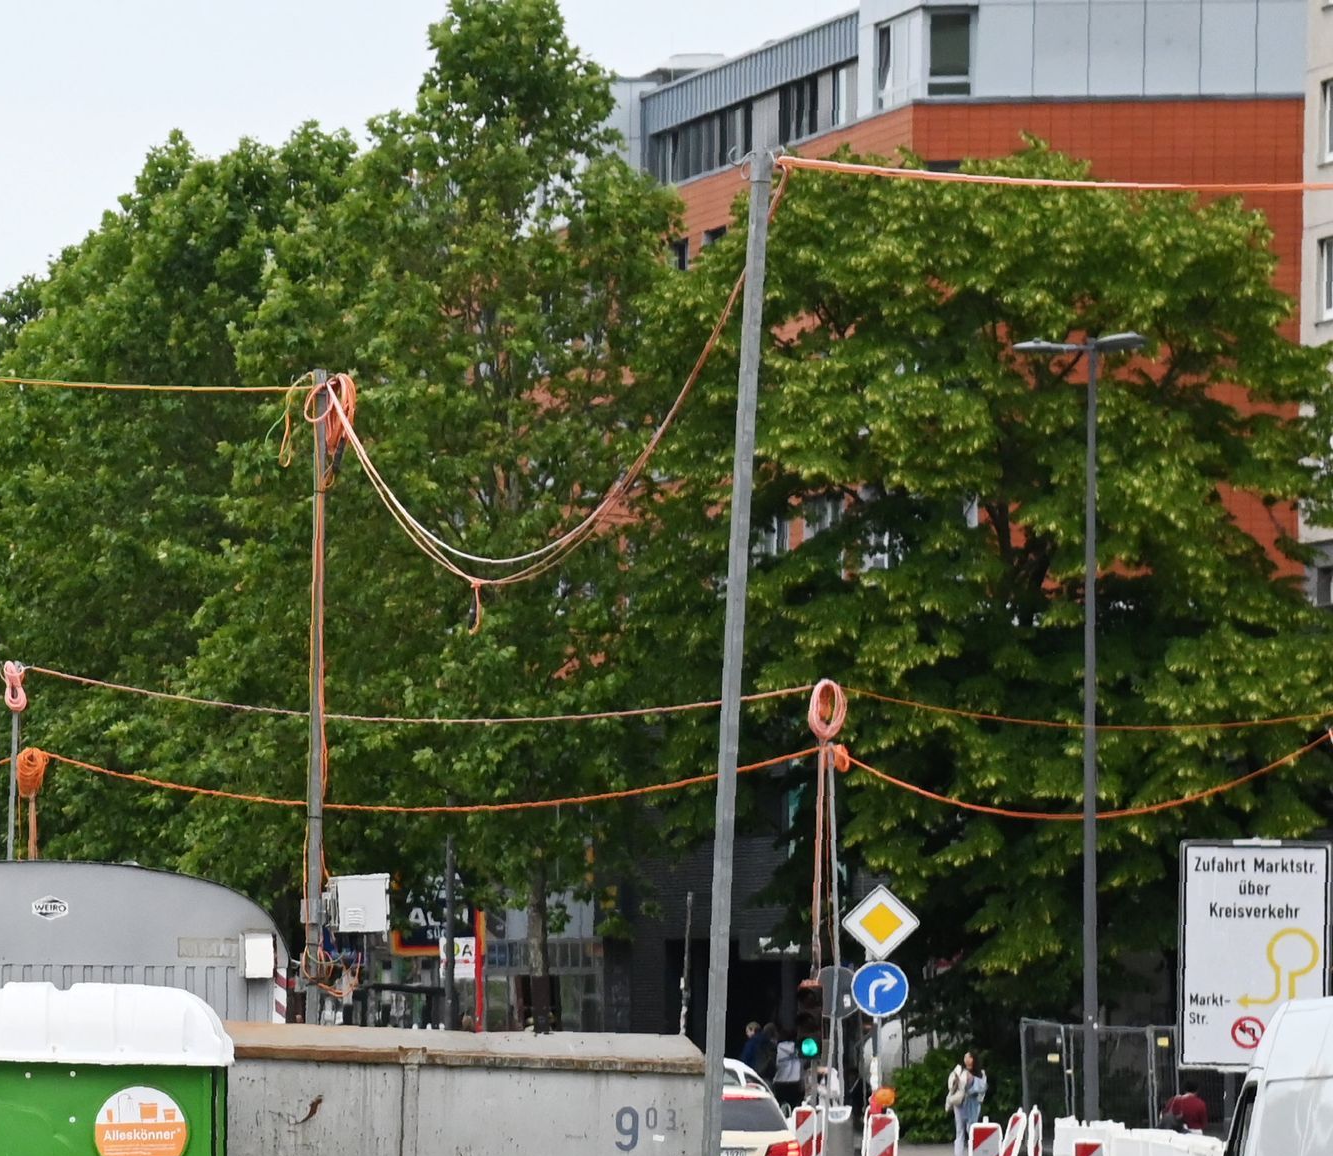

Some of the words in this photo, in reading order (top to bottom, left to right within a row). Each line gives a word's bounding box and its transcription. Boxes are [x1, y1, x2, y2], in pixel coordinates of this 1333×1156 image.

[1194, 857, 1246, 873] Zufahrt
[1253, 857, 1318, 874] Marktstr.
[1238, 880, 1271, 896] über
[1209, 902, 1300, 919] Kreisverkehr
[1189, 993, 1231, 1007] Markt-
[1189, 1012, 1208, 1025] Str.
